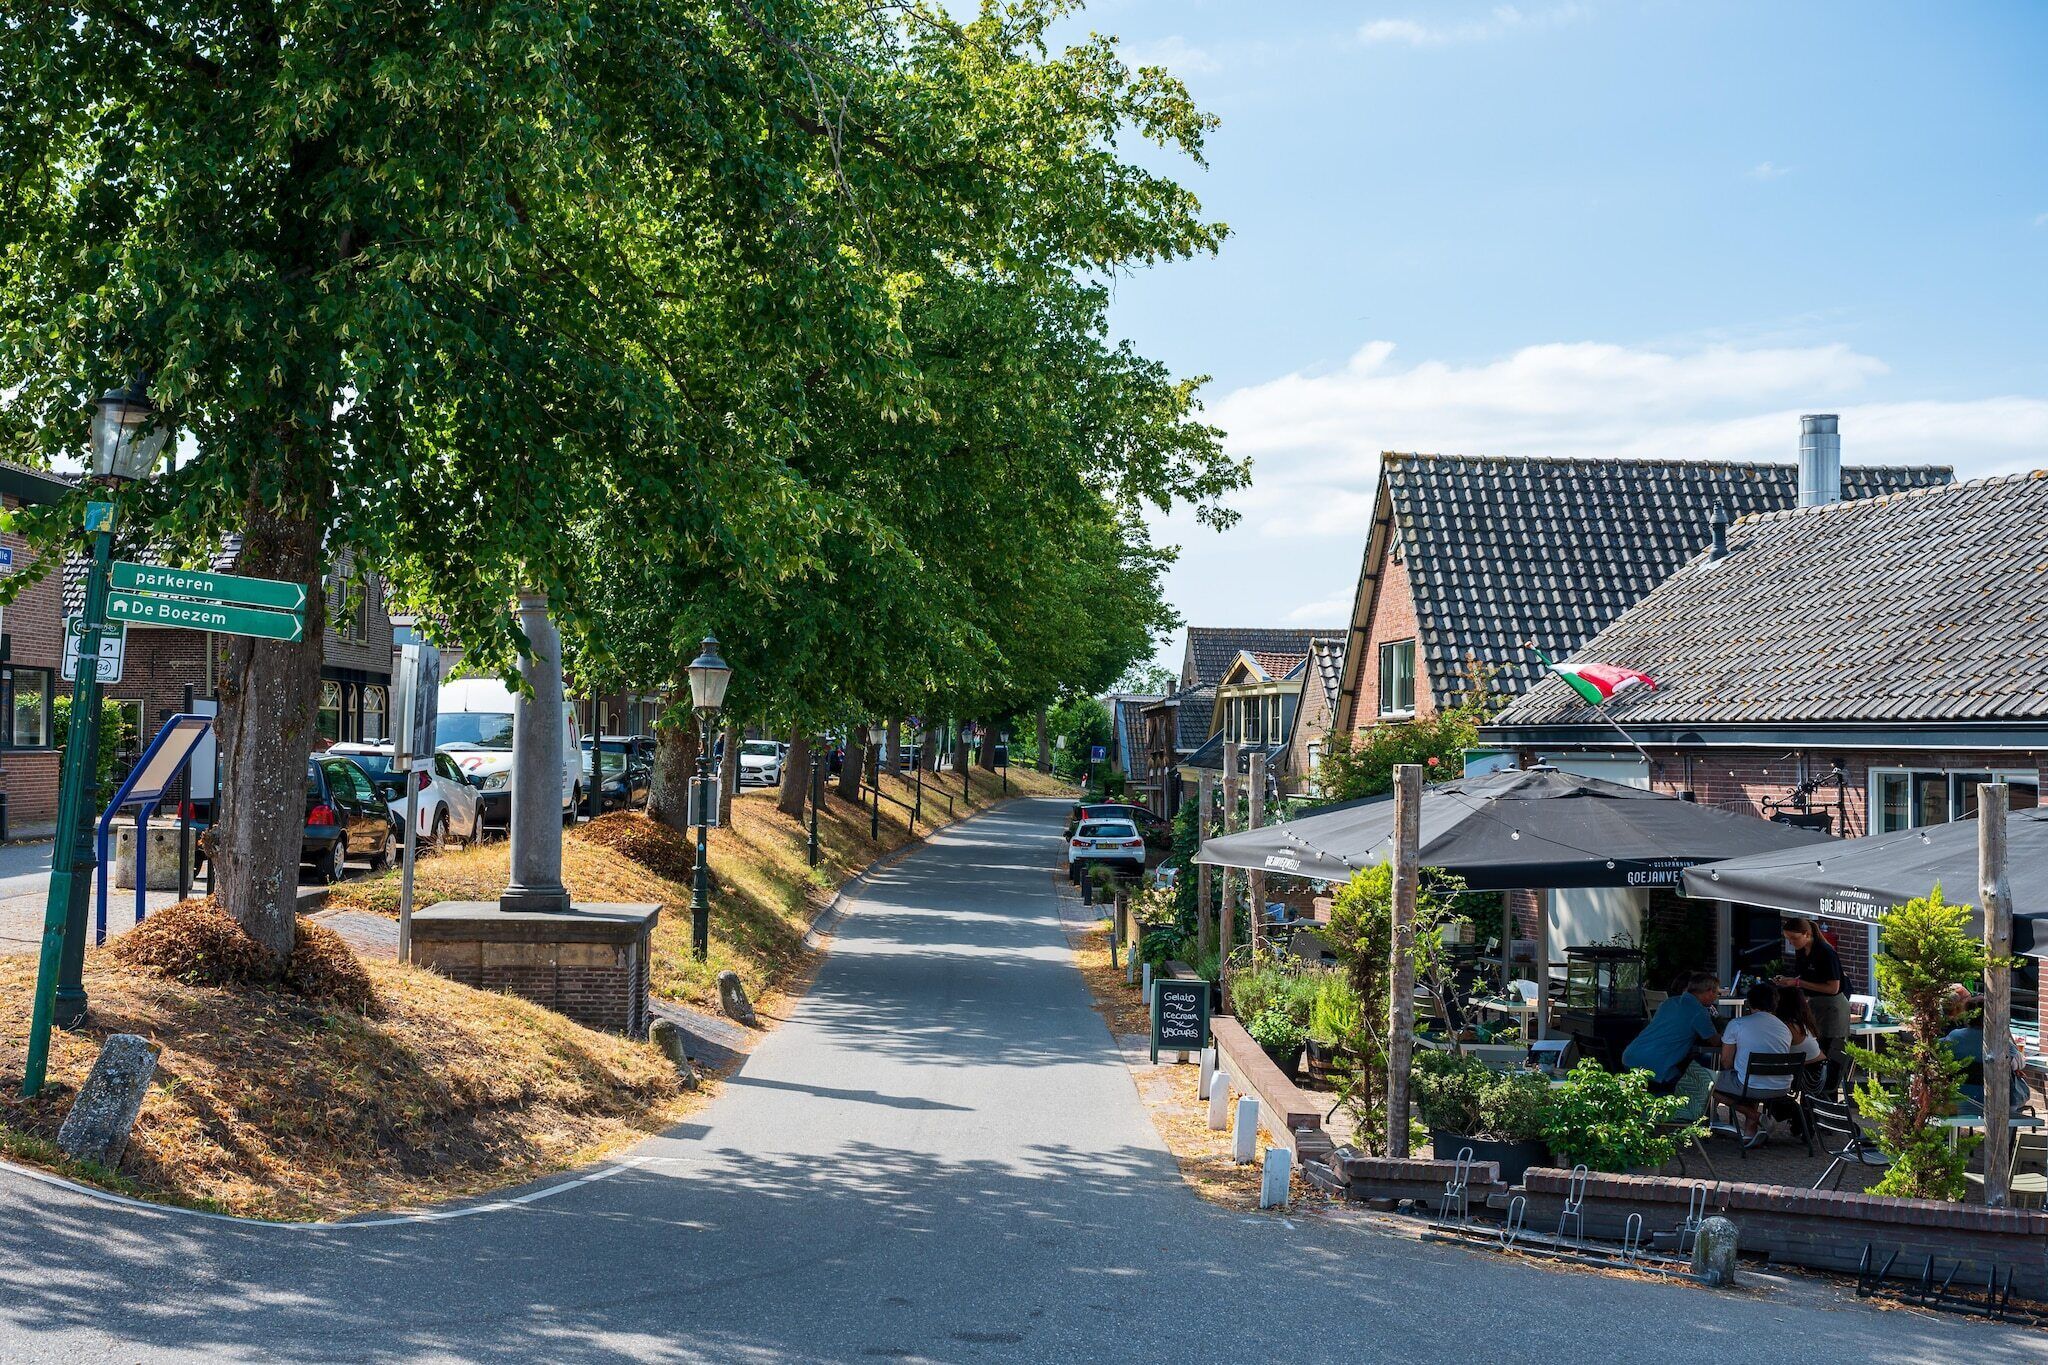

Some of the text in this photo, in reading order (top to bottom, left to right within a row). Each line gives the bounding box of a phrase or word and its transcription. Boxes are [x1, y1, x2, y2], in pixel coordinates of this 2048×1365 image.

[135, 573, 213, 591] parkeren
[132, 601, 226, 624] De Boezem
[1627, 870, 1682, 885] GOEJANVE
[1164, 992, 1196, 1002] Gelato
